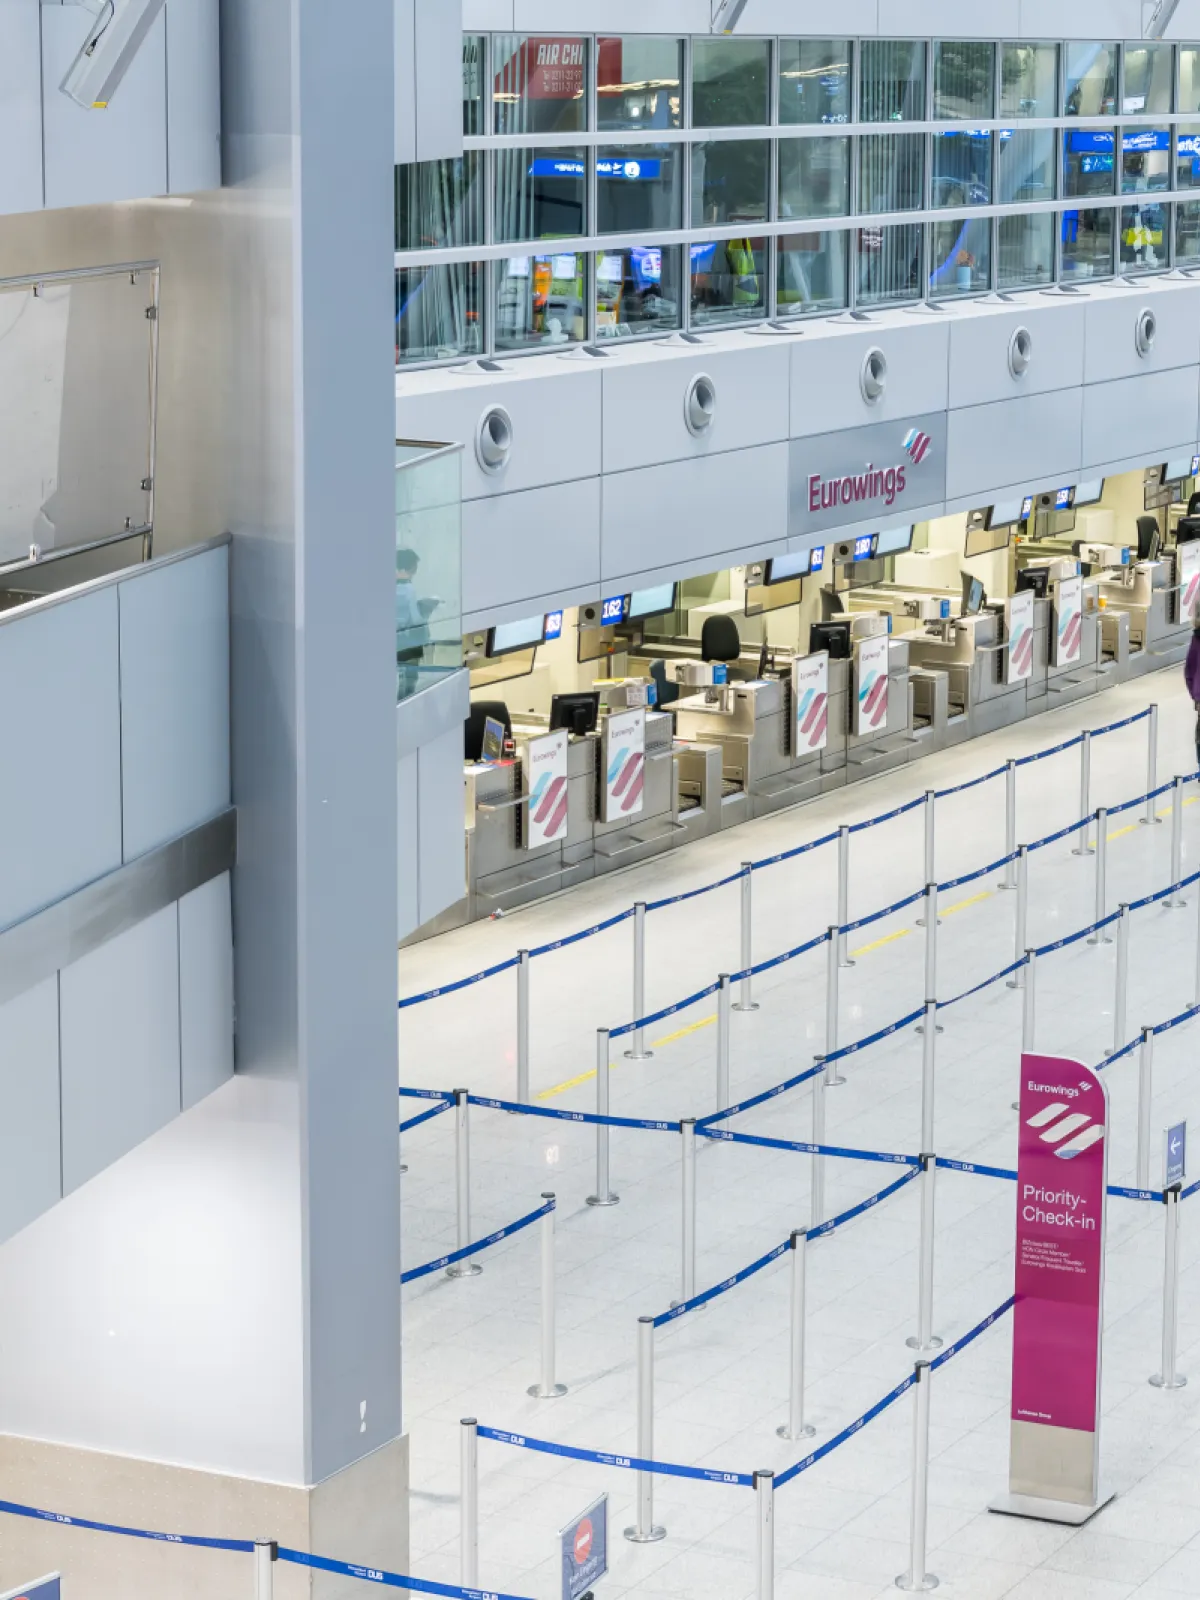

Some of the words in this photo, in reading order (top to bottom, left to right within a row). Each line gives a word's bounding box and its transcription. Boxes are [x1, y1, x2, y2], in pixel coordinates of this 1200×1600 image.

[537, 44, 560, 65] AIR
[808, 463, 905, 511] Eurowings
[812, 549, 823, 566] 61
[602, 600, 621, 619] 162
[545, 614, 562, 633] 63
[1028, 1081, 1079, 1098] Eurowings
[1023, 1184, 1087, 1210] Priority-
[1022, 1205, 1095, 1230] Check-in
